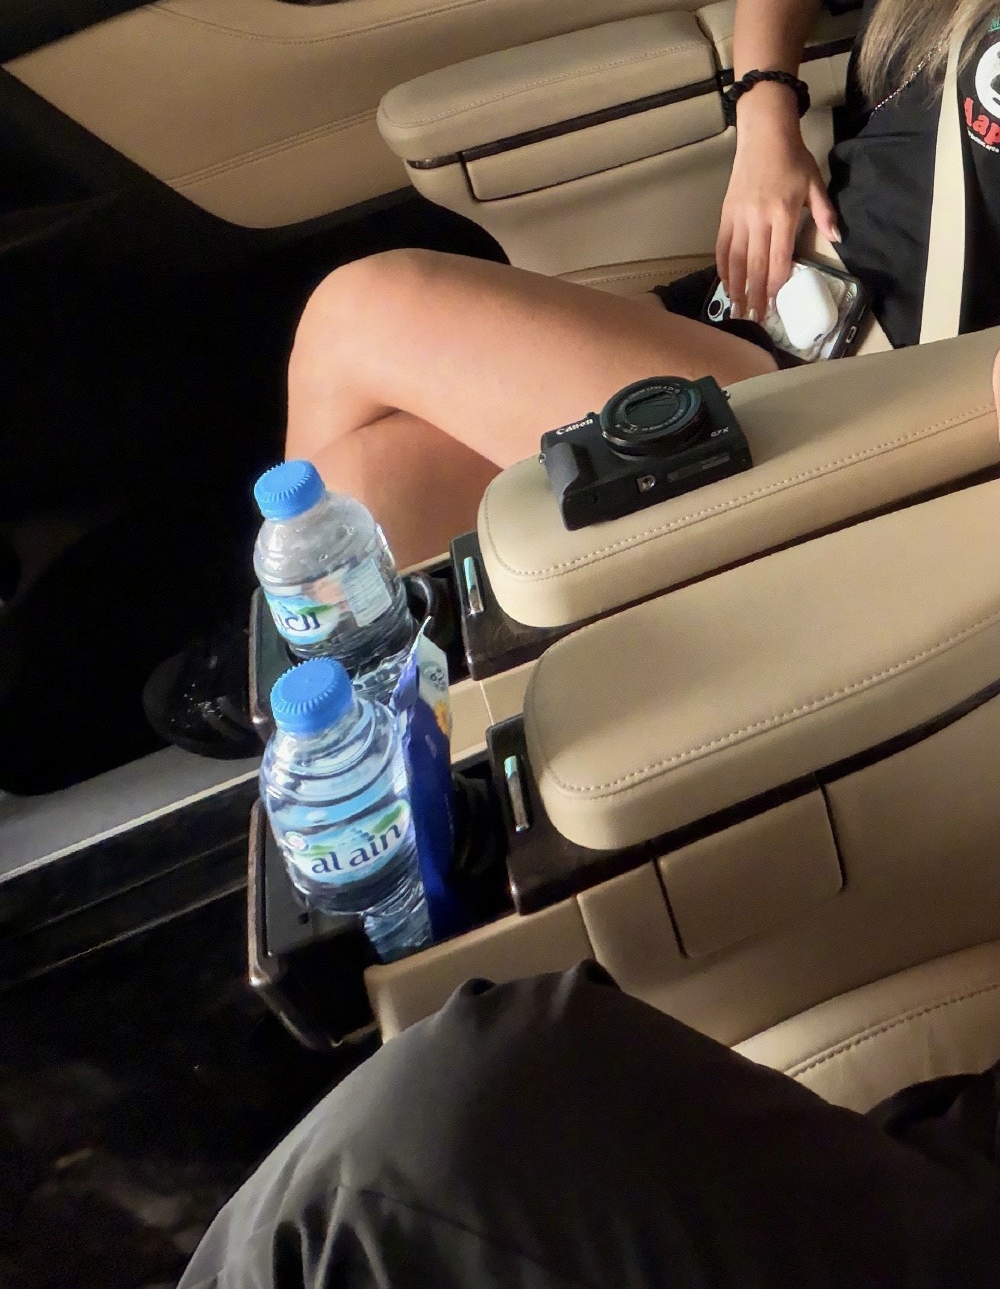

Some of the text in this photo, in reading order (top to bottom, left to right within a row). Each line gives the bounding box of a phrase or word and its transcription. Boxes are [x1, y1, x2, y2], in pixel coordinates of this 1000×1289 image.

[555, 418, 593, 435] Canon
[311, 823, 401, 874] al ain
